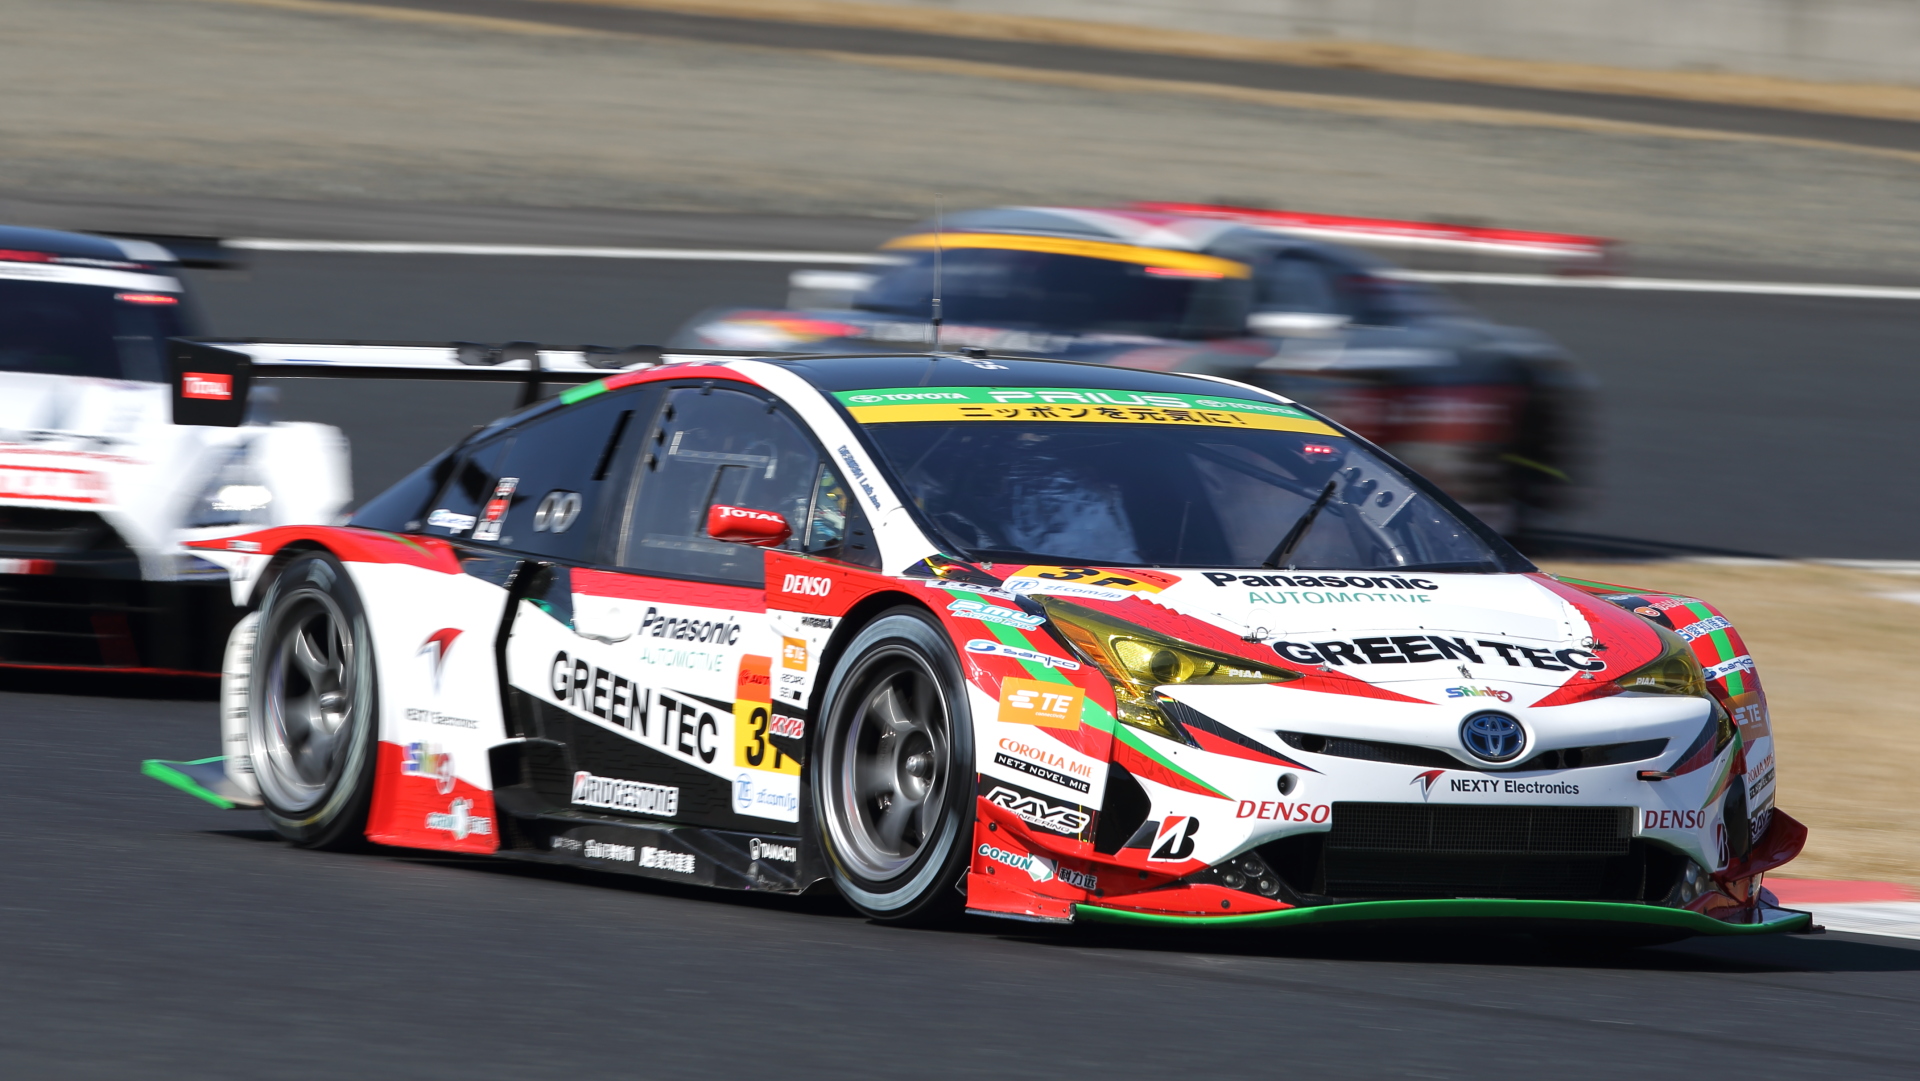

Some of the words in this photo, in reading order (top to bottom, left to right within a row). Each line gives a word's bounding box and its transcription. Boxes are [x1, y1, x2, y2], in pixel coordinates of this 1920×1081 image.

[881, 393, 970, 401] TOYOTA
[988, 391, 1192, 408] PRIUS
[959, 405, 1247, 425] ニッポンを元気に!
[1227, 401, 1304, 416] TOYOTA
[718, 506, 785, 524] TOTAL
[782, 573, 831, 597] DENSO
[1043, 583, 1122, 599] zf.com/jp
[1202, 572, 1438, 591] Panasonic
[1249, 591, 1432, 604] AUTOMOTIVE
[638, 607, 741, 646] Panasonic
[1272, 634, 1482, 668] GREEN
[1478, 637, 1608, 673] TEC
[1228, 668, 1263, 679] PIAA
[548, 650, 650, 737] GREEN
[658, 692, 719, 765] TEC
[1042, 692, 1074, 714] TE
[1746, 704, 1761, 723] TE
[998, 737, 1065, 769] COROLLA
[998, 755, 1026, 771] NETZ
[1029, 766, 1066, 785] NOVEL
[1069, 780, 1088, 792] MIE
[1450, 779, 1499, 793] NEXTY
[1504, 780, 1580, 795] Electronics
[988, 790, 1086, 831] RAYS
[1236, 800, 1330, 823] DENSO
[1644, 810, 1706, 829] DENSO
[979, 844, 1033, 870] CORUN
